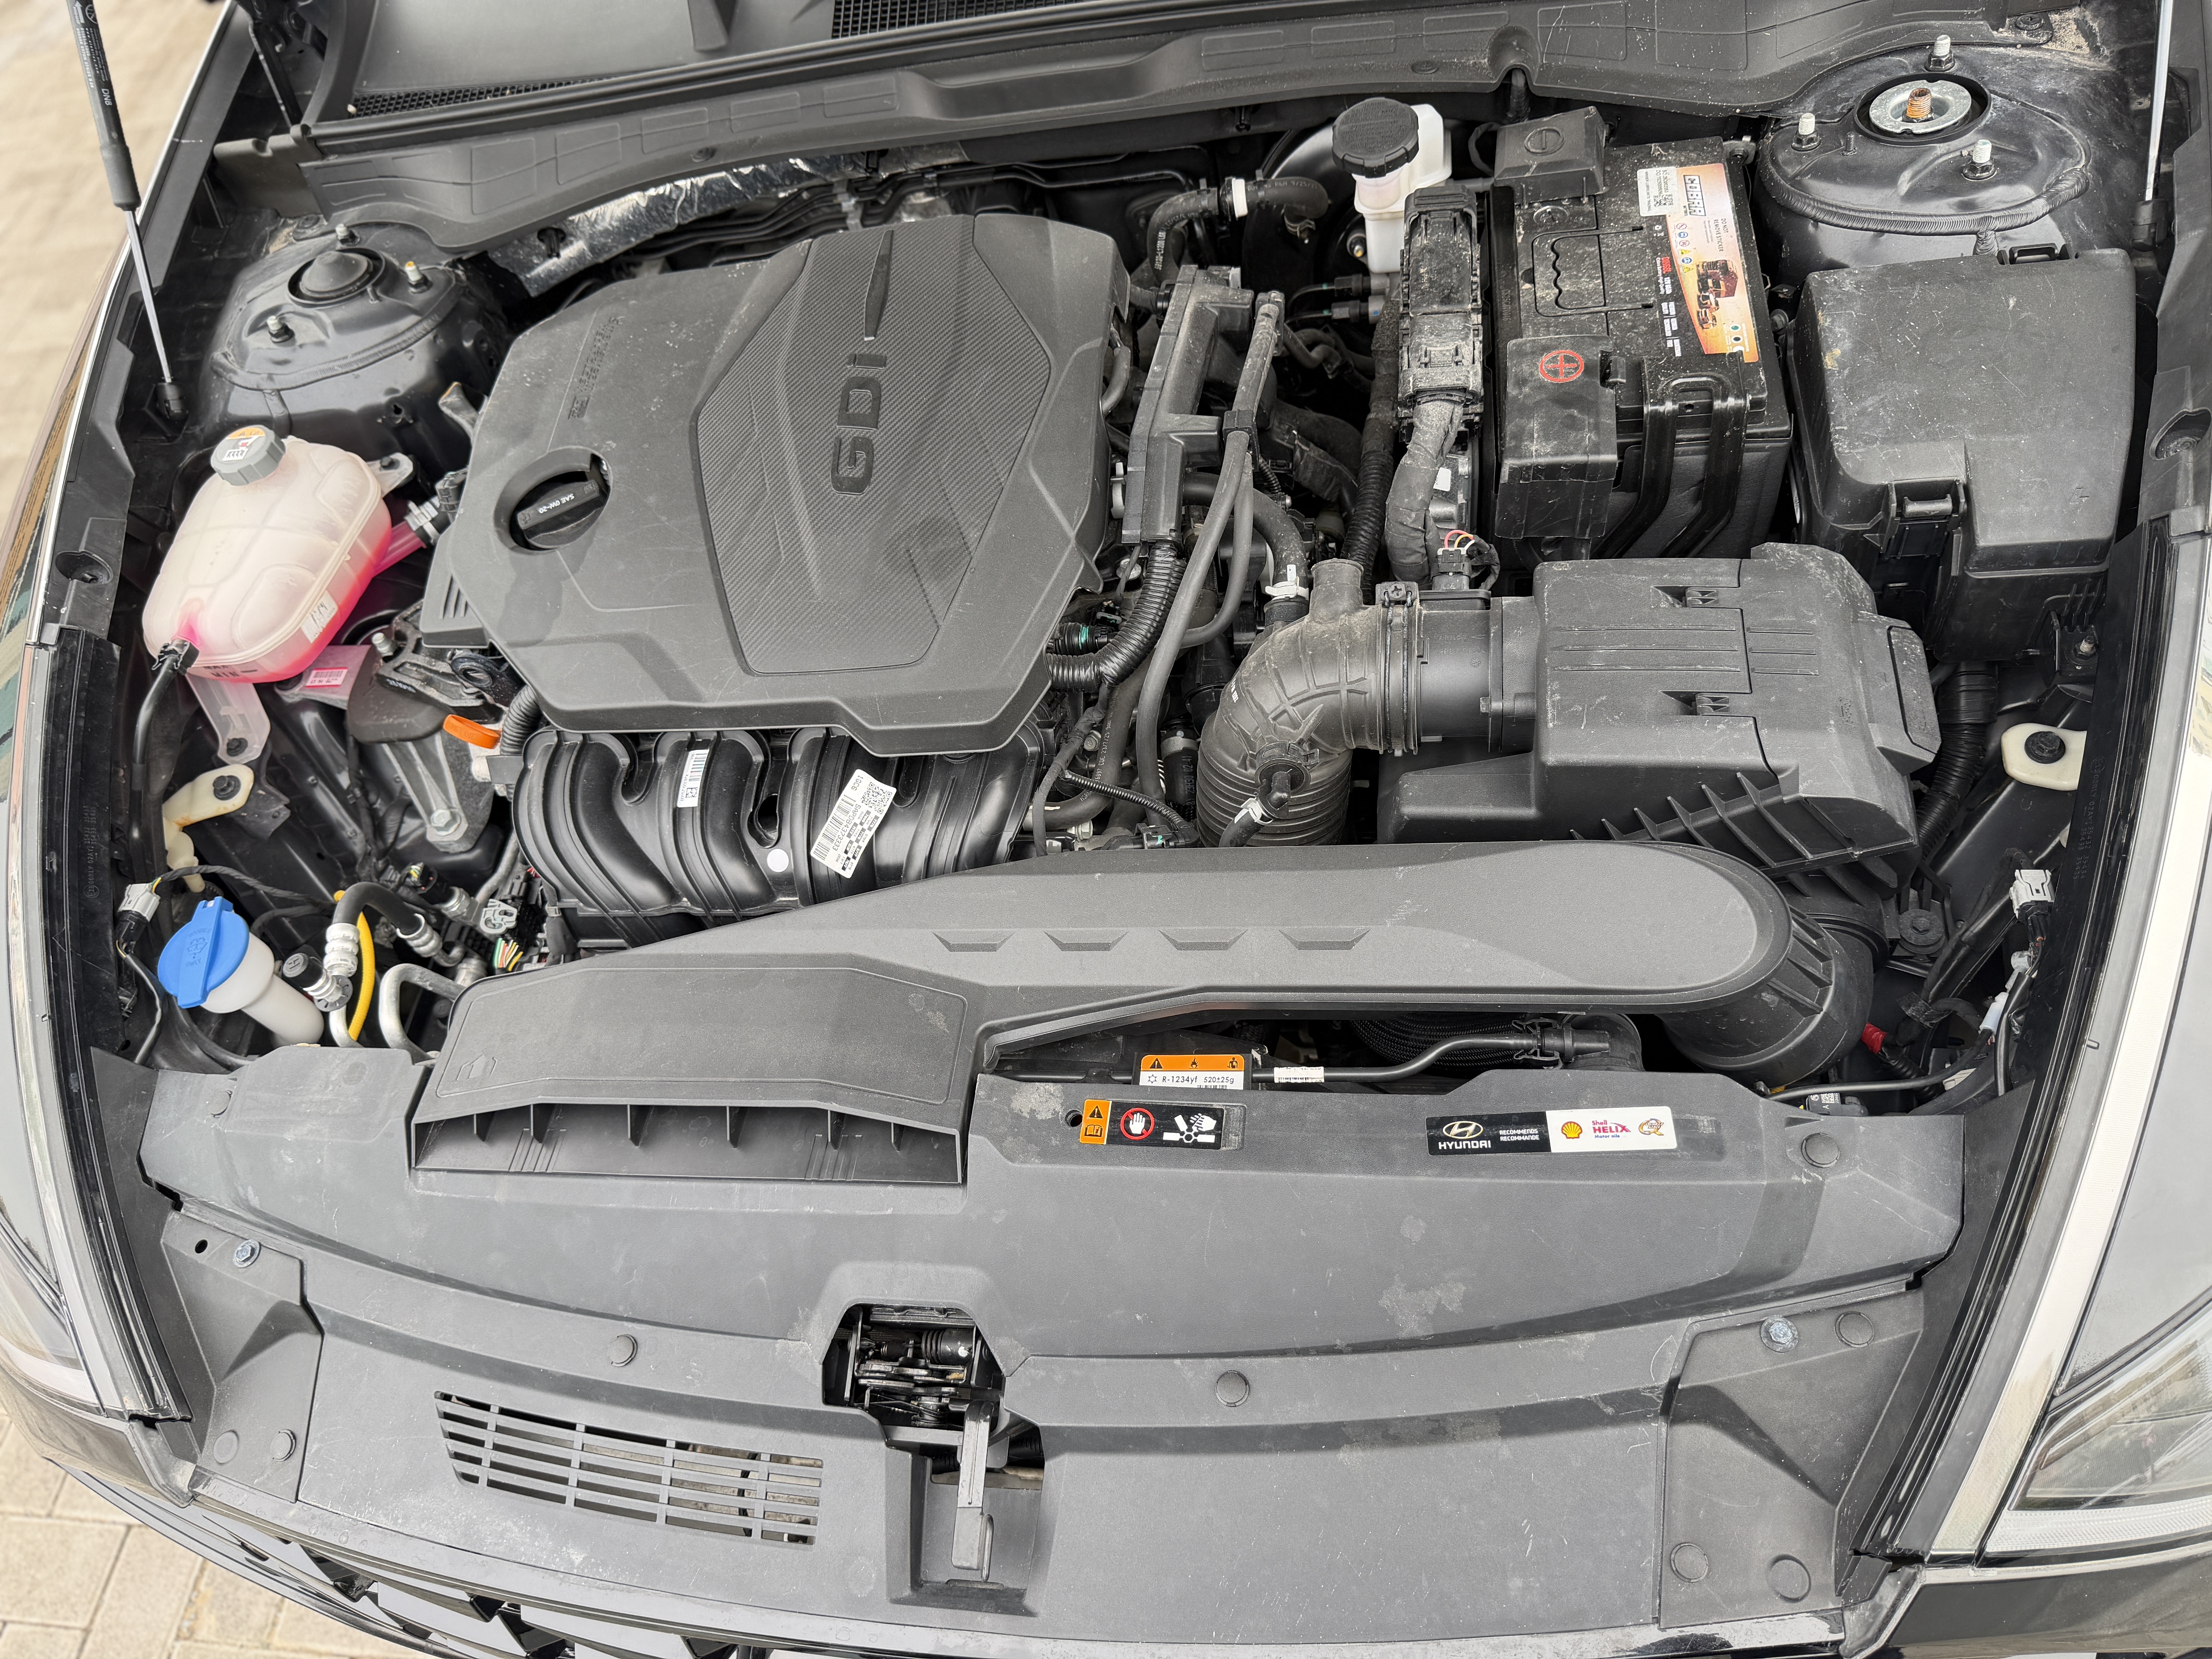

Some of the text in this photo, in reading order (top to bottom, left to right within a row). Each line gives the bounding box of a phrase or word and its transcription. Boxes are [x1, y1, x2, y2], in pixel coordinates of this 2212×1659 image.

[101, 89, 112, 105] DN8
[1683, 175, 1706, 216] COBRA
[538, 493, 575, 514] SAE 0W-20
[851, 775, 864, 791] 1GC6
[832, 803, 862, 851] SAPDB4373333
[1162, 1075, 1235, 1084] R-1234yf 520±25g
[1592, 1124, 1631, 1133] HELIX
[1438, 1140, 1491, 1150] HYUNDAI
